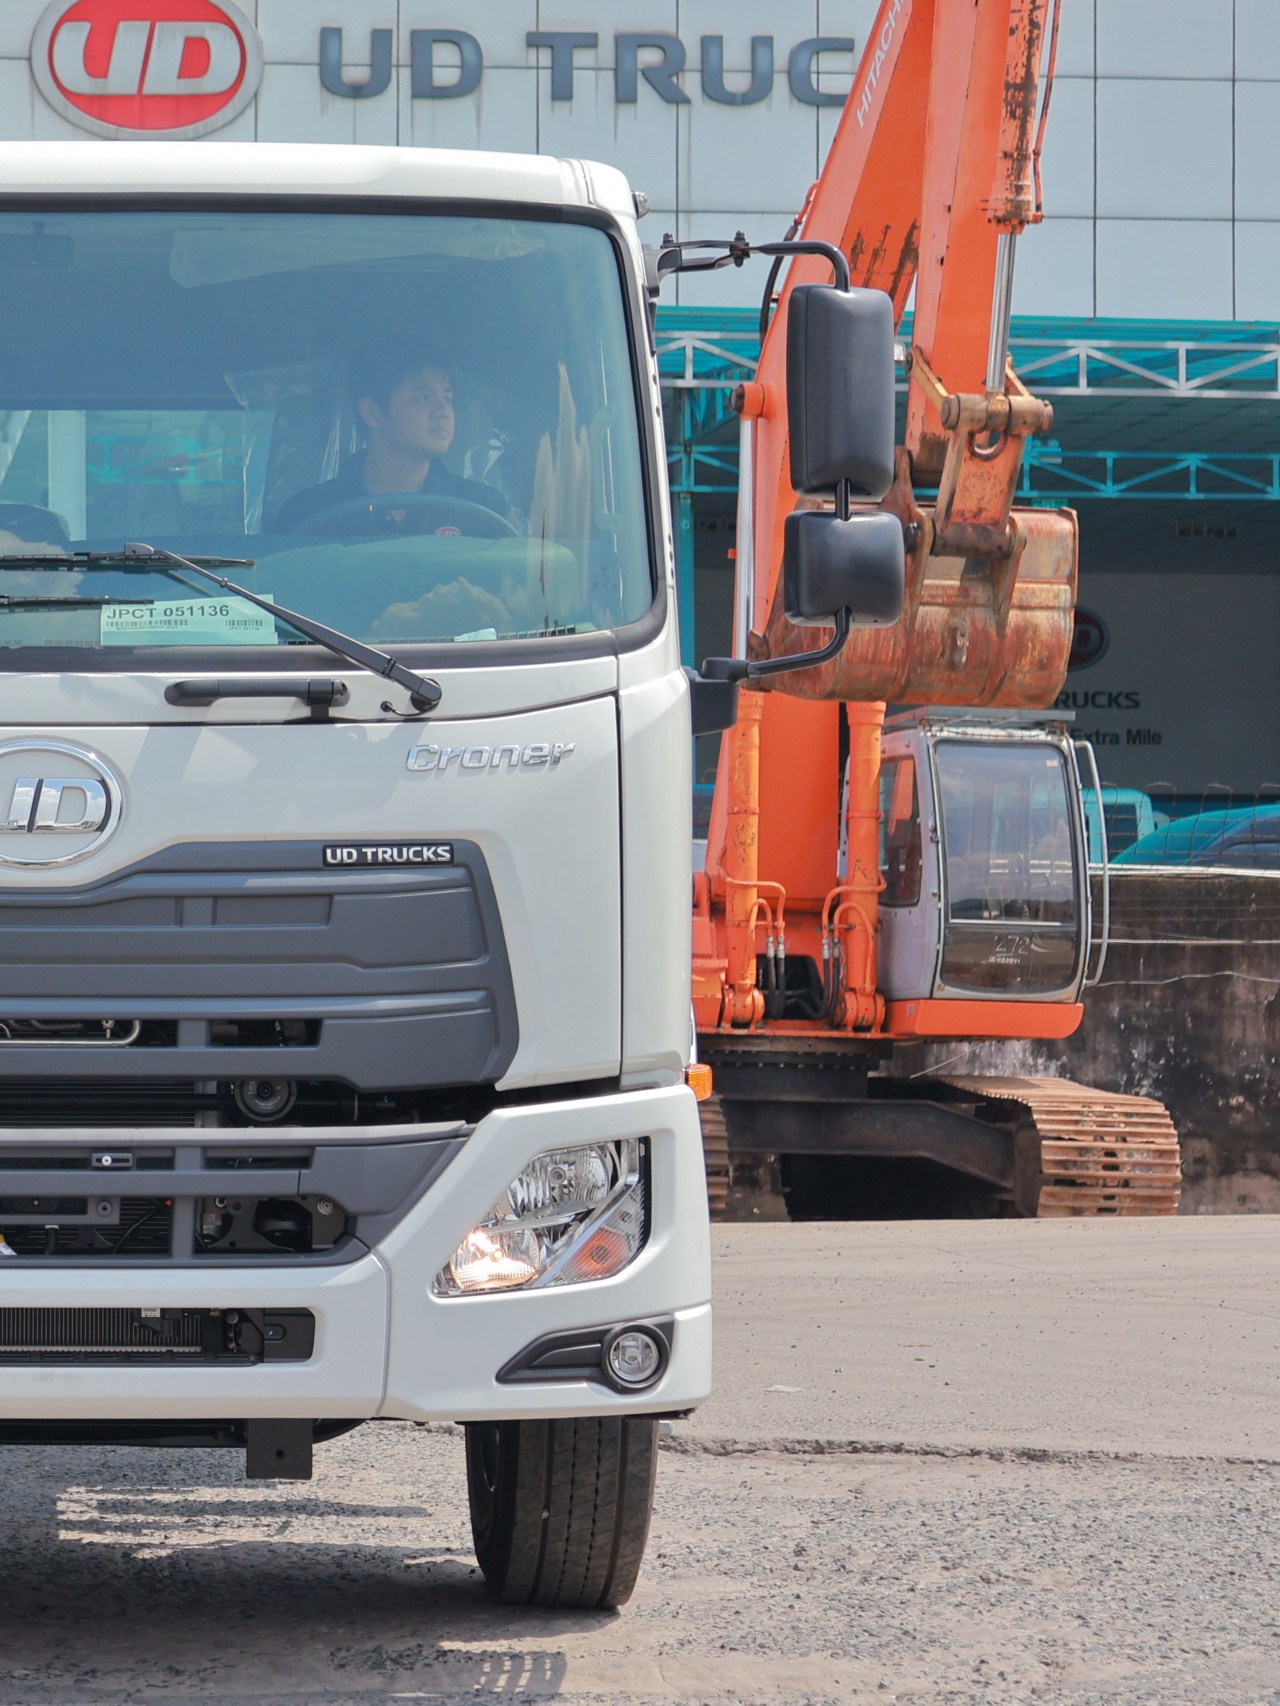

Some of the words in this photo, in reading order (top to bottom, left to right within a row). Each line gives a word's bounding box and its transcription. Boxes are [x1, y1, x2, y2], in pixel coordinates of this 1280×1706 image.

[52, 20, 242, 96] UD
[319, 26, 484, 99] UD
[526, 31, 855, 107] TRUC
[856, 0, 902, 128] HITACH
[106, 608, 157, 619] JPCT
[163, 605, 230, 618] 051136
[1054, 691, 1140, 709] RUCKS
[1126, 728, 1162, 745] Mile
[406, 742, 576, 771] Croner
[326, 848, 358, 863] UD
[362, 846, 451, 862] TRUCKS
